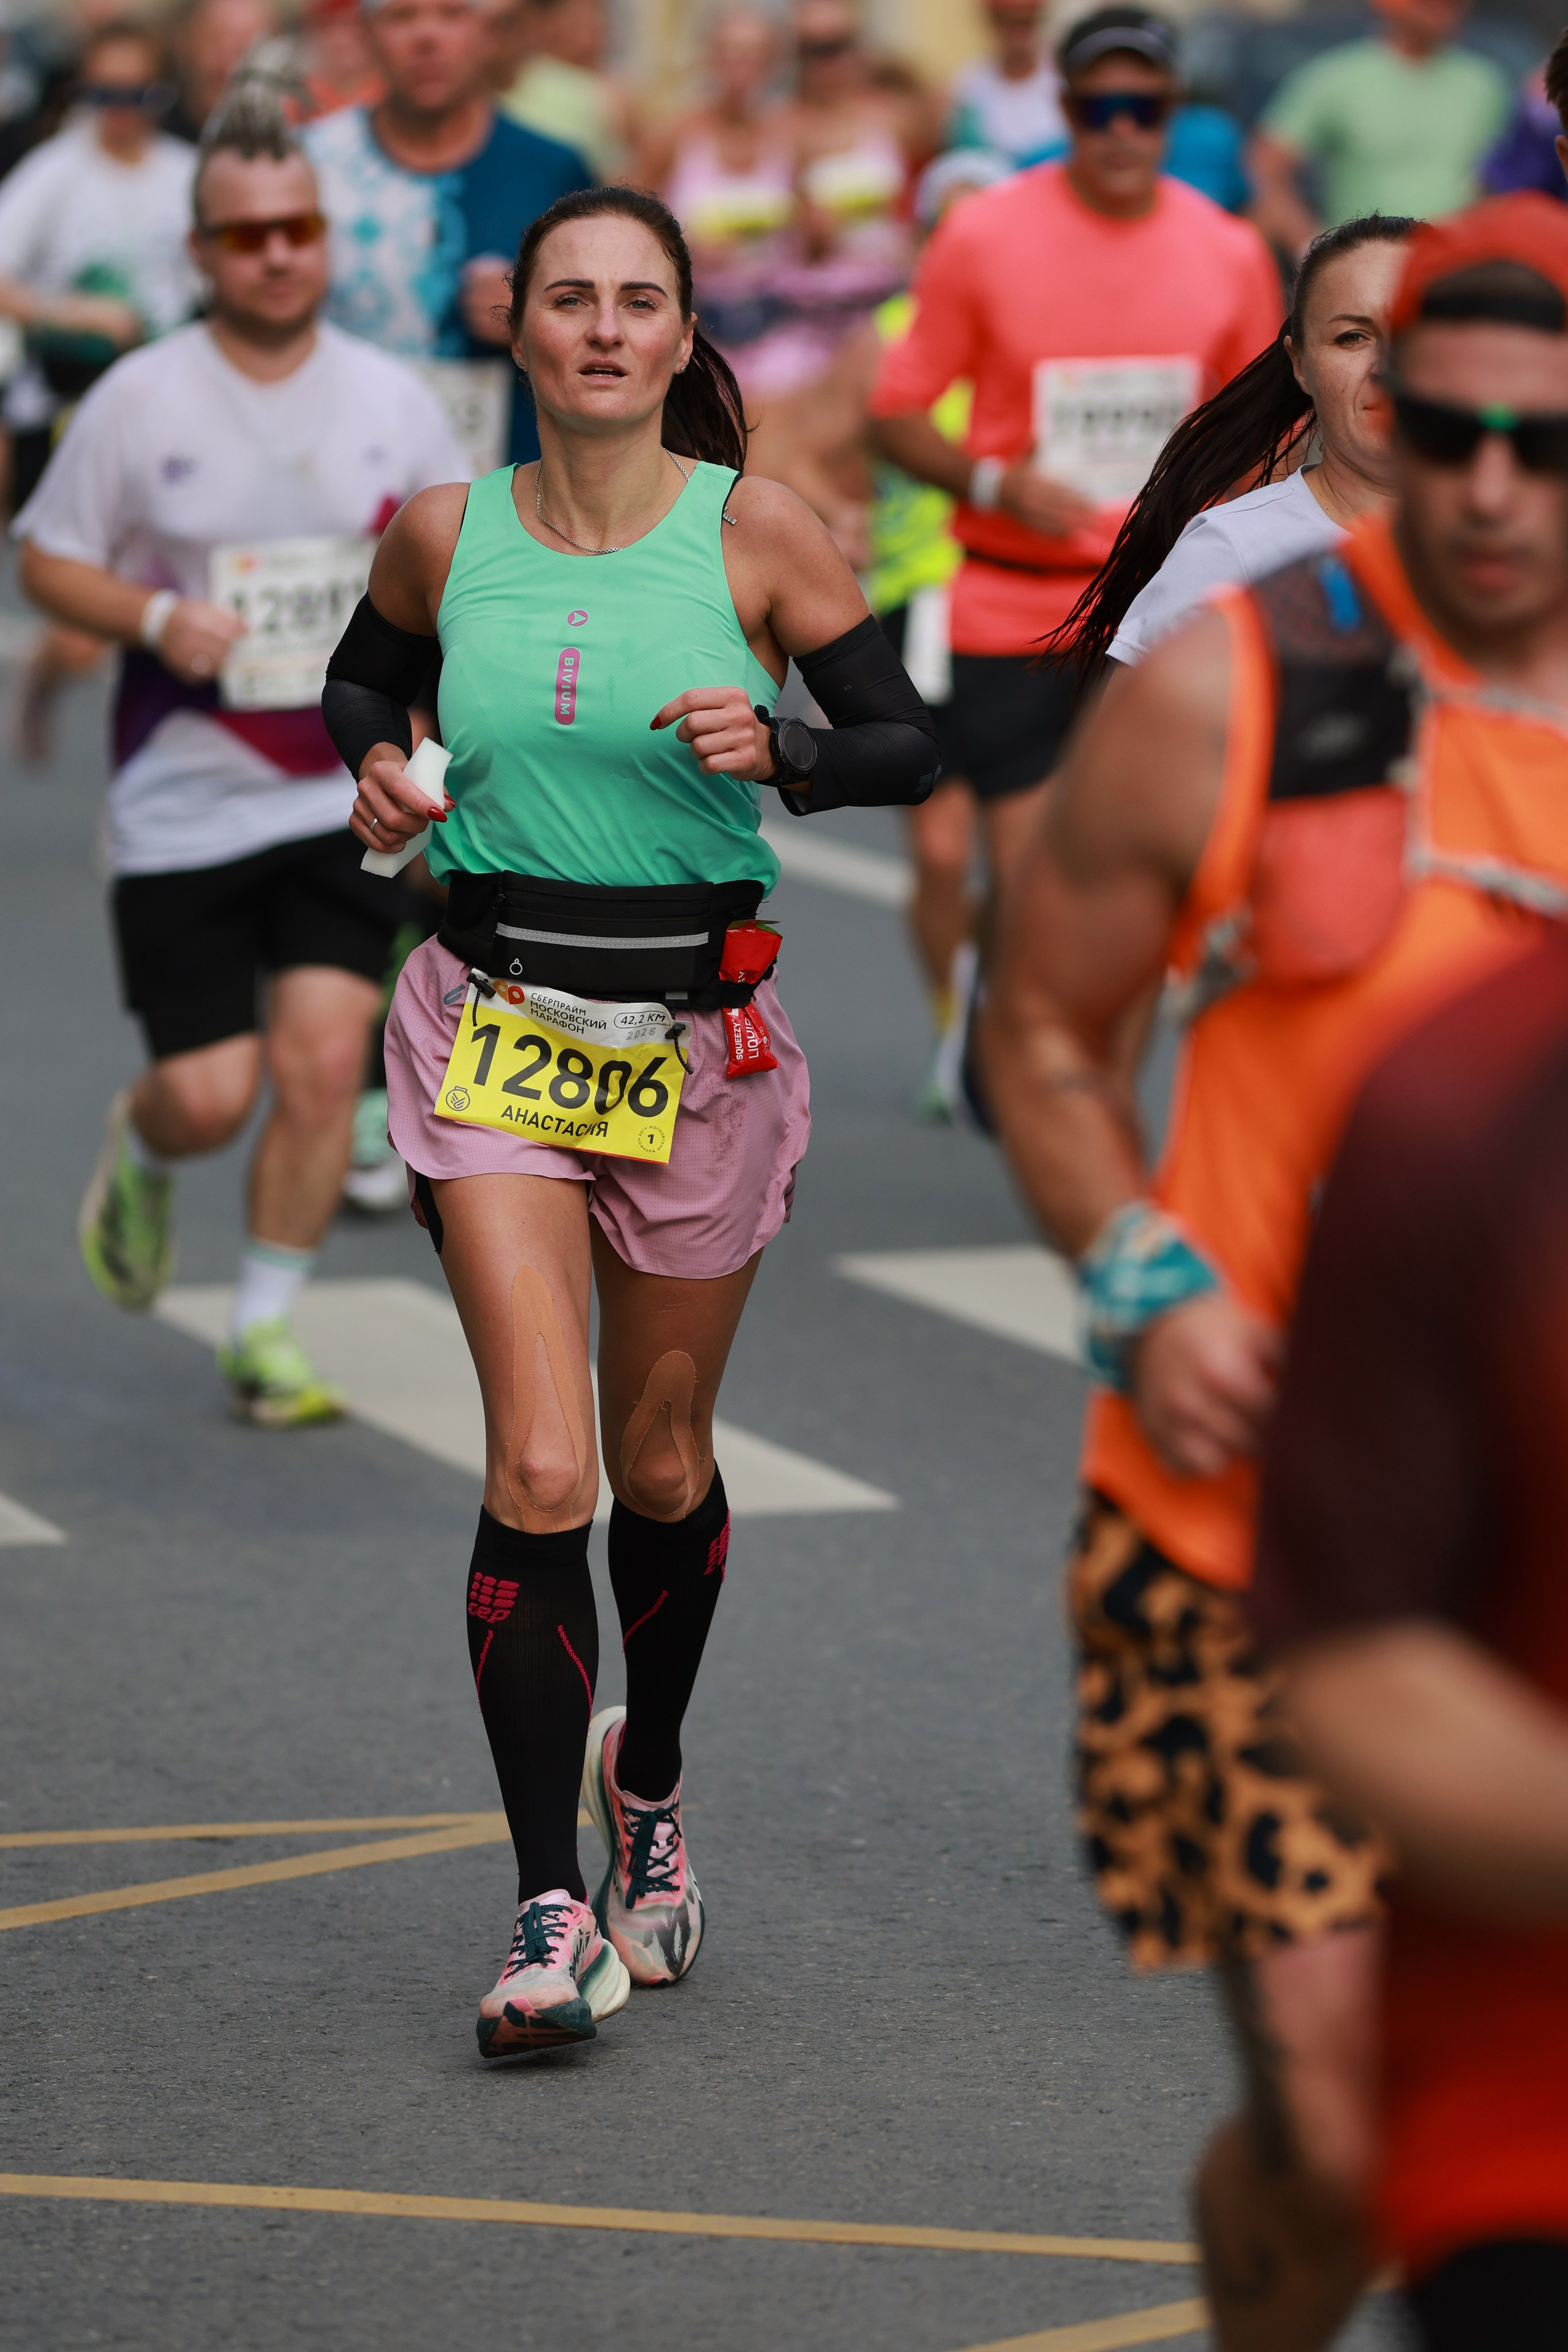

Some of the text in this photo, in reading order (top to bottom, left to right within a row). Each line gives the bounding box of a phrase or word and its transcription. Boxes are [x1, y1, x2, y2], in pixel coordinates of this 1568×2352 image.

[560, 657, 575, 715] BIVIUM
[530, 1000, 606, 1030] МОСКОВСКИЙ
[531, 992, 586, 1016] СБЕРПРАЙМ
[530, 1008, 584, 1035] МАРАФОН
[620, 1014, 645, 1026] 42,2
[626, 1027, 657, 1040] 2026
[733, 1022, 744, 1060] SQUEEZY
[470, 1023, 669, 1118] 12806
[500, 1104, 609, 1138] АНАСТАСИЯ
[647, 1134, 654, 1144] 1
